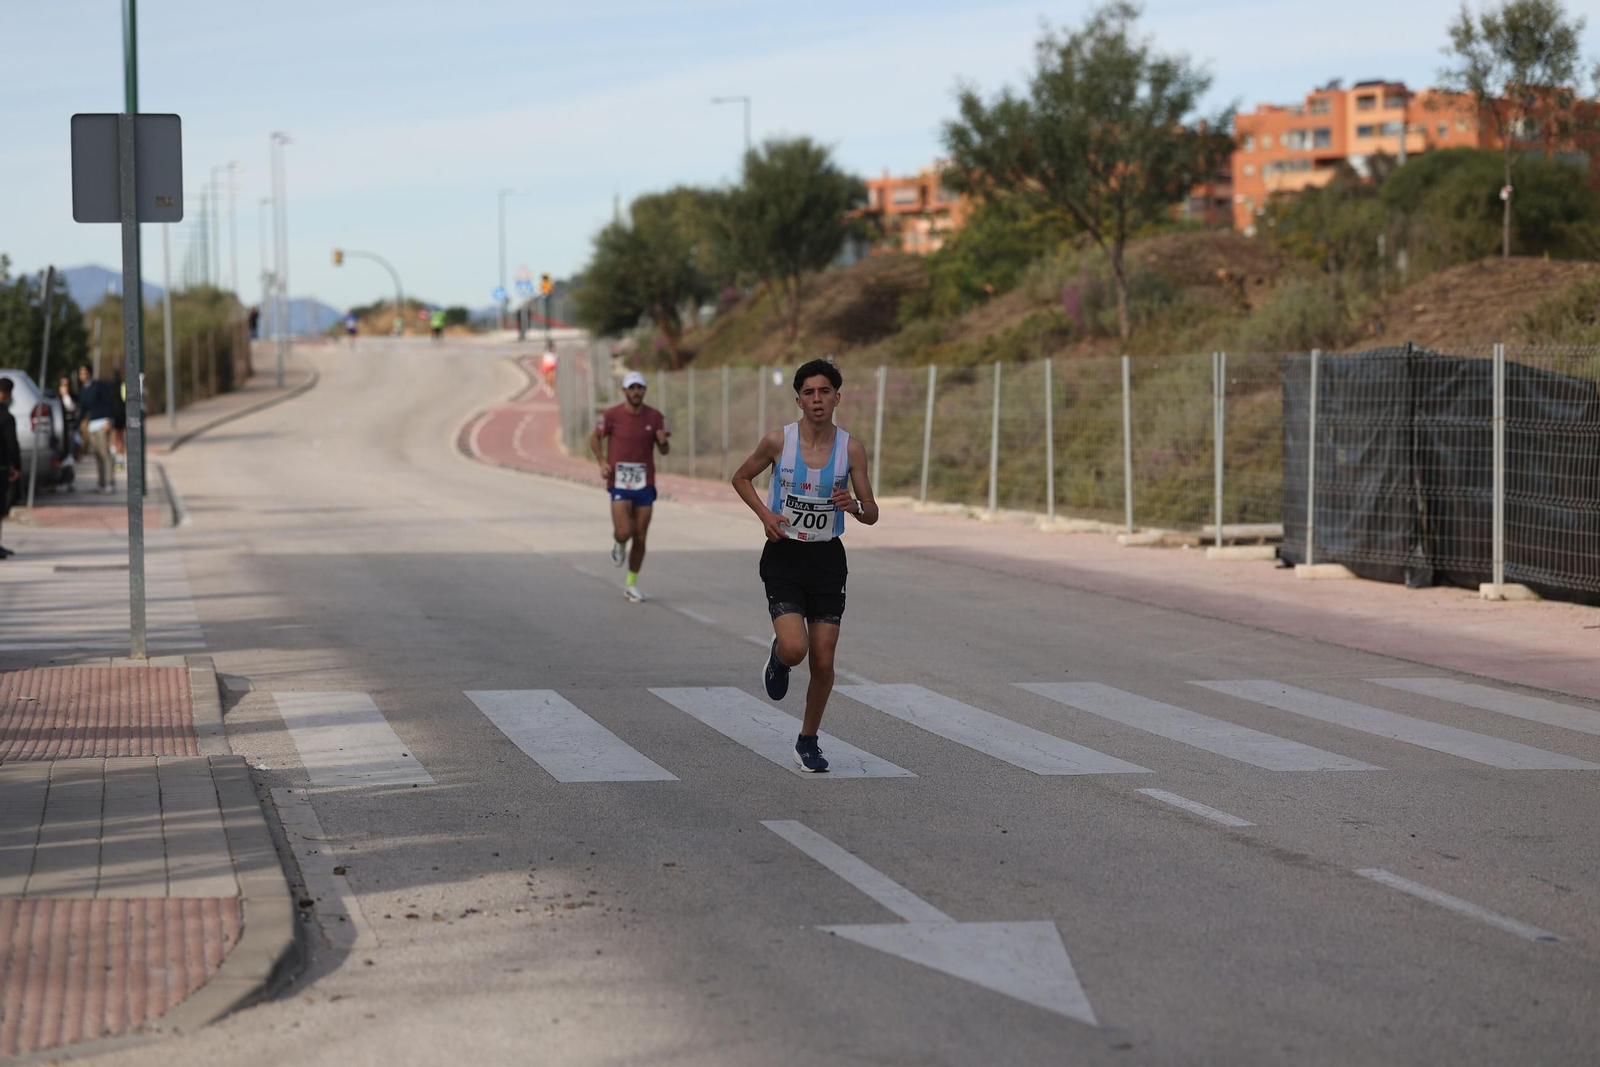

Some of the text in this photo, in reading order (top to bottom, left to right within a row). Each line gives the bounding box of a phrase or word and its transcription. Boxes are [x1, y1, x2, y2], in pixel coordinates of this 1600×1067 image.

[621, 472, 642, 483] 276
[787, 500, 810, 510] UMA
[792, 510, 828, 530] 700
